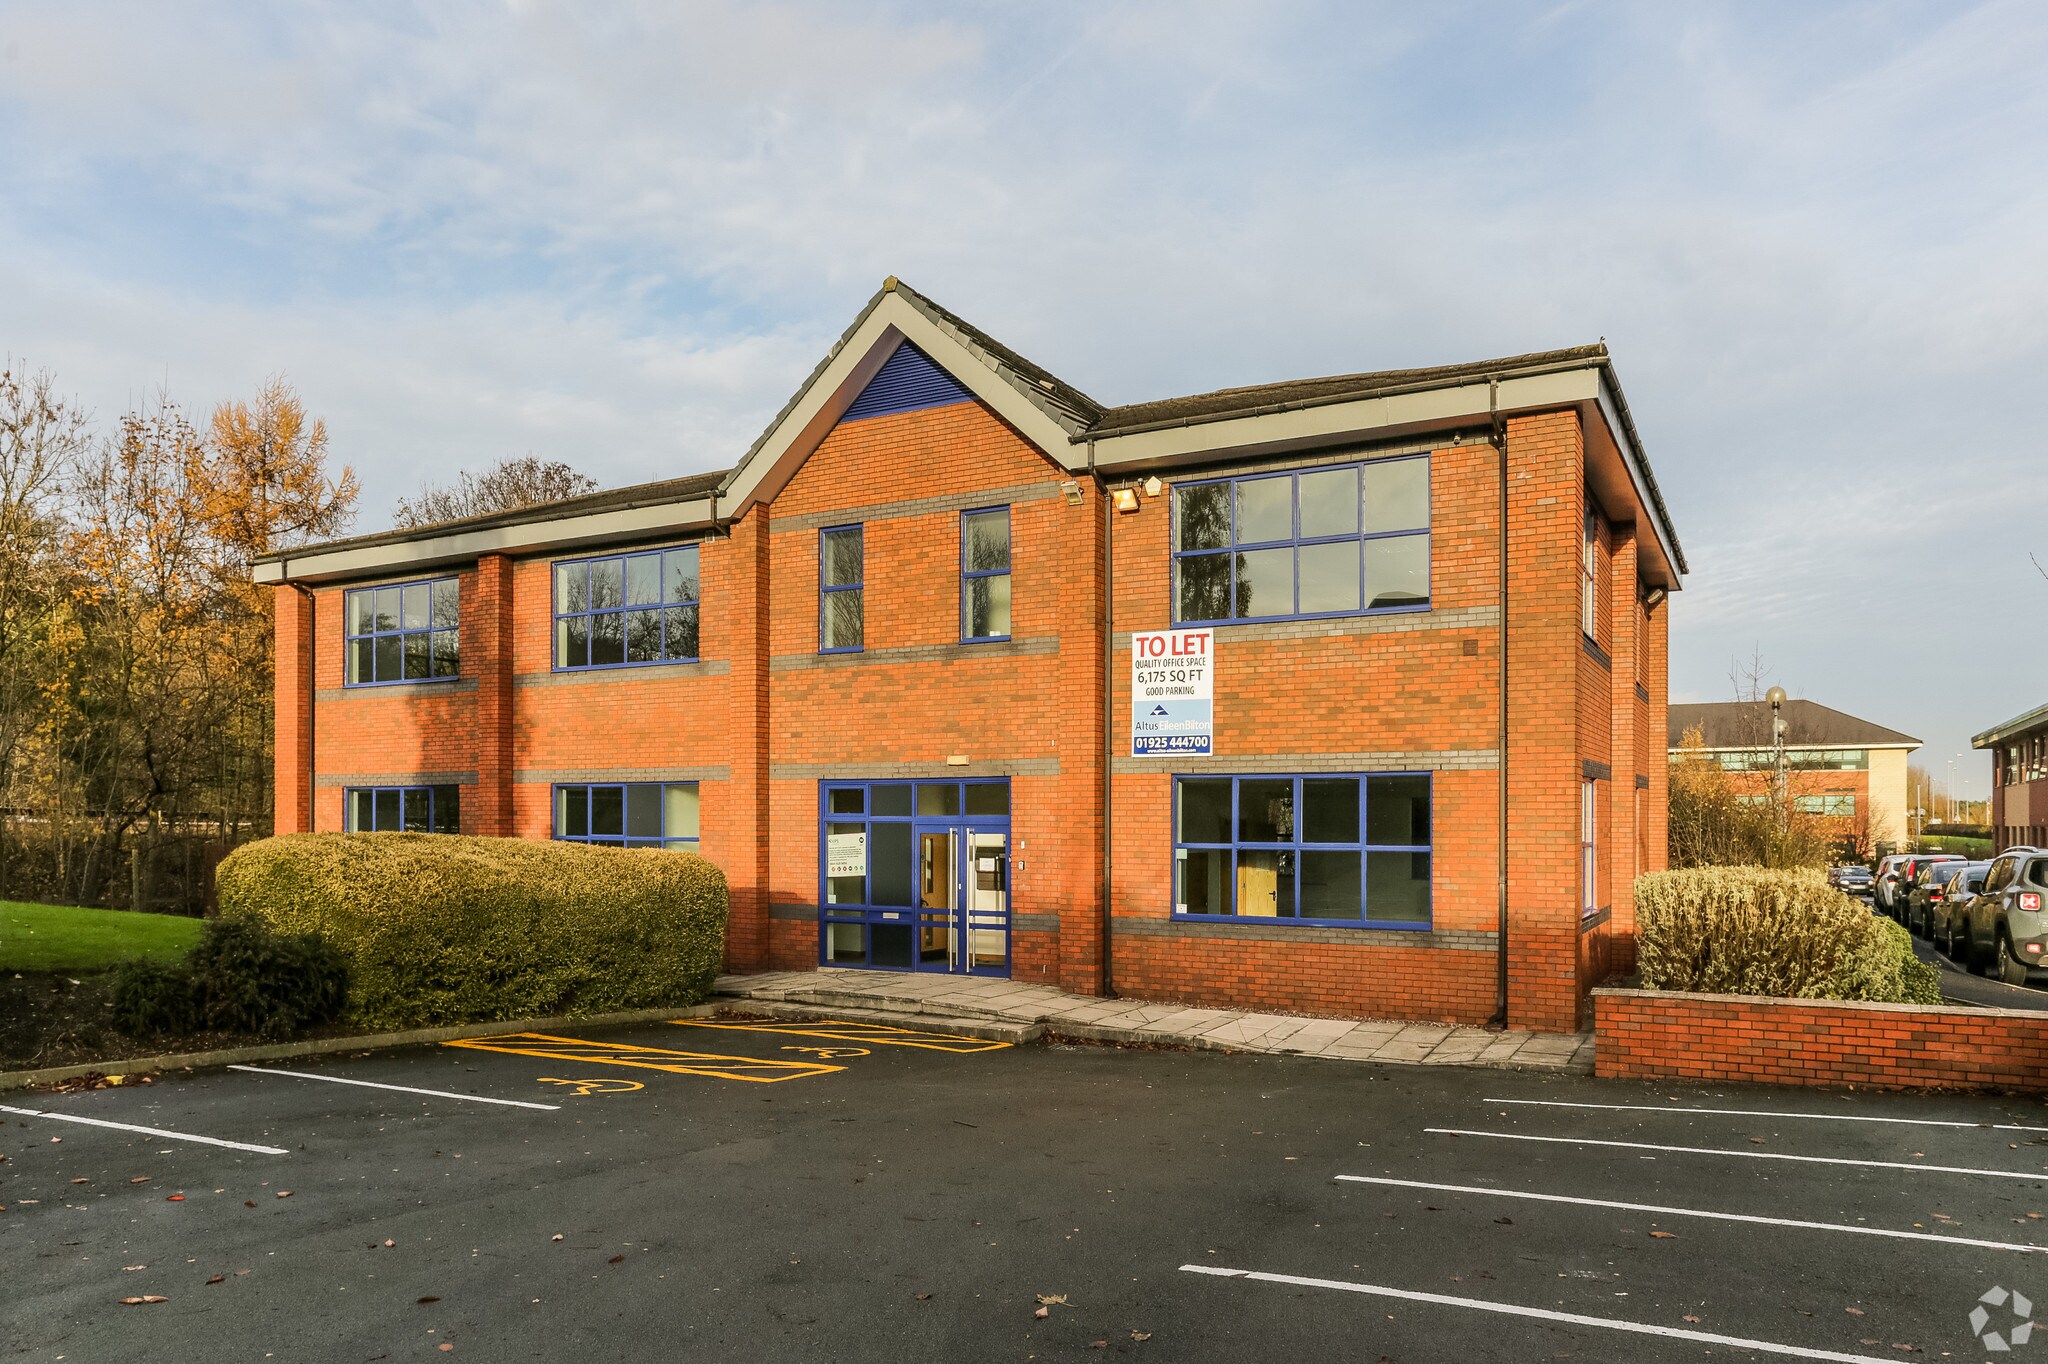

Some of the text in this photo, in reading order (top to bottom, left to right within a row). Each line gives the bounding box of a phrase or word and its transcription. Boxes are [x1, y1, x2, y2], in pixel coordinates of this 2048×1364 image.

[1136, 634, 1210, 657] TO LET
[1135, 657, 1206, 668] QUALITY OFFICE SPACE
[1138, 669, 1203, 684] 6,175 SQ FT
[1146, 686, 1195, 696] GOOD PARKING
[1136, 736, 1208, 748] 01925 444700
